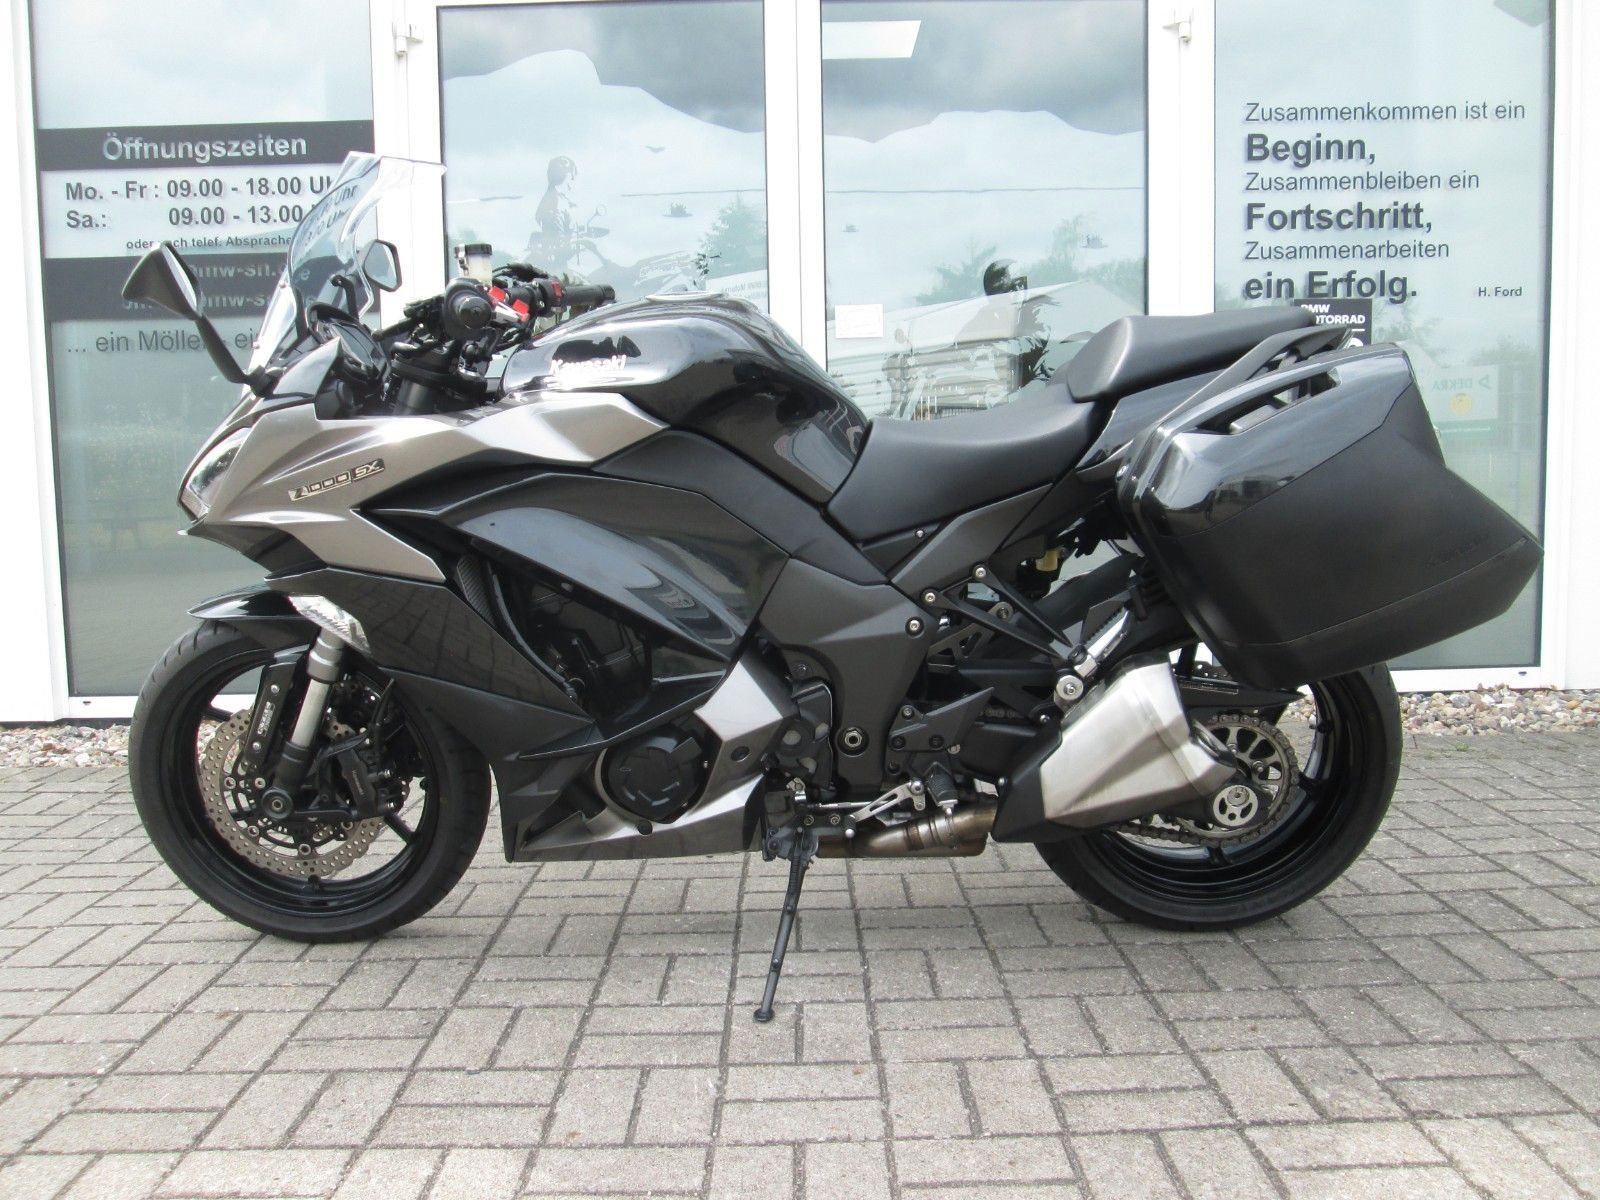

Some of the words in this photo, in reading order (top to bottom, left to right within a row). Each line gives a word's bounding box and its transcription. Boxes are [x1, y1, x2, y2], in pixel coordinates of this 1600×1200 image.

[1245, 101, 1457, 122] Zusammenkommen
[1464, 101, 1488, 119] ist
[1495, 100, 1525, 119] ein
[103, 132, 307, 164] Öffnungszeiten
[1247, 133, 1376, 168] Beginn,
[65, 182, 104, 201] Mo.
[167, 179, 223, 198] 09.00
[246, 176, 302, 196] 18.00
[1245, 171, 1441, 191] Zusammenbleiben
[1449, 170, 1480, 189] ein
[66, 210, 107, 228] Sa.:
[168, 207, 225, 226] 09.00
[247, 204, 303, 224] 13.00
[1247, 201, 1432, 233] Fortschritt,
[192, 236, 222, 247] telef.
[1244, 240, 1449, 260] Zusammenarbeiten
[1245, 271, 1295, 299] ein
[1308, 270, 1417, 304] Erfolg.
[1478, 287, 1491, 297] H.
[1494, 287, 1523, 297] Ford
[95, 331, 129, 352] ein
[138, 330, 206, 351] Mölle
[234, 328, 258, 349] ei
